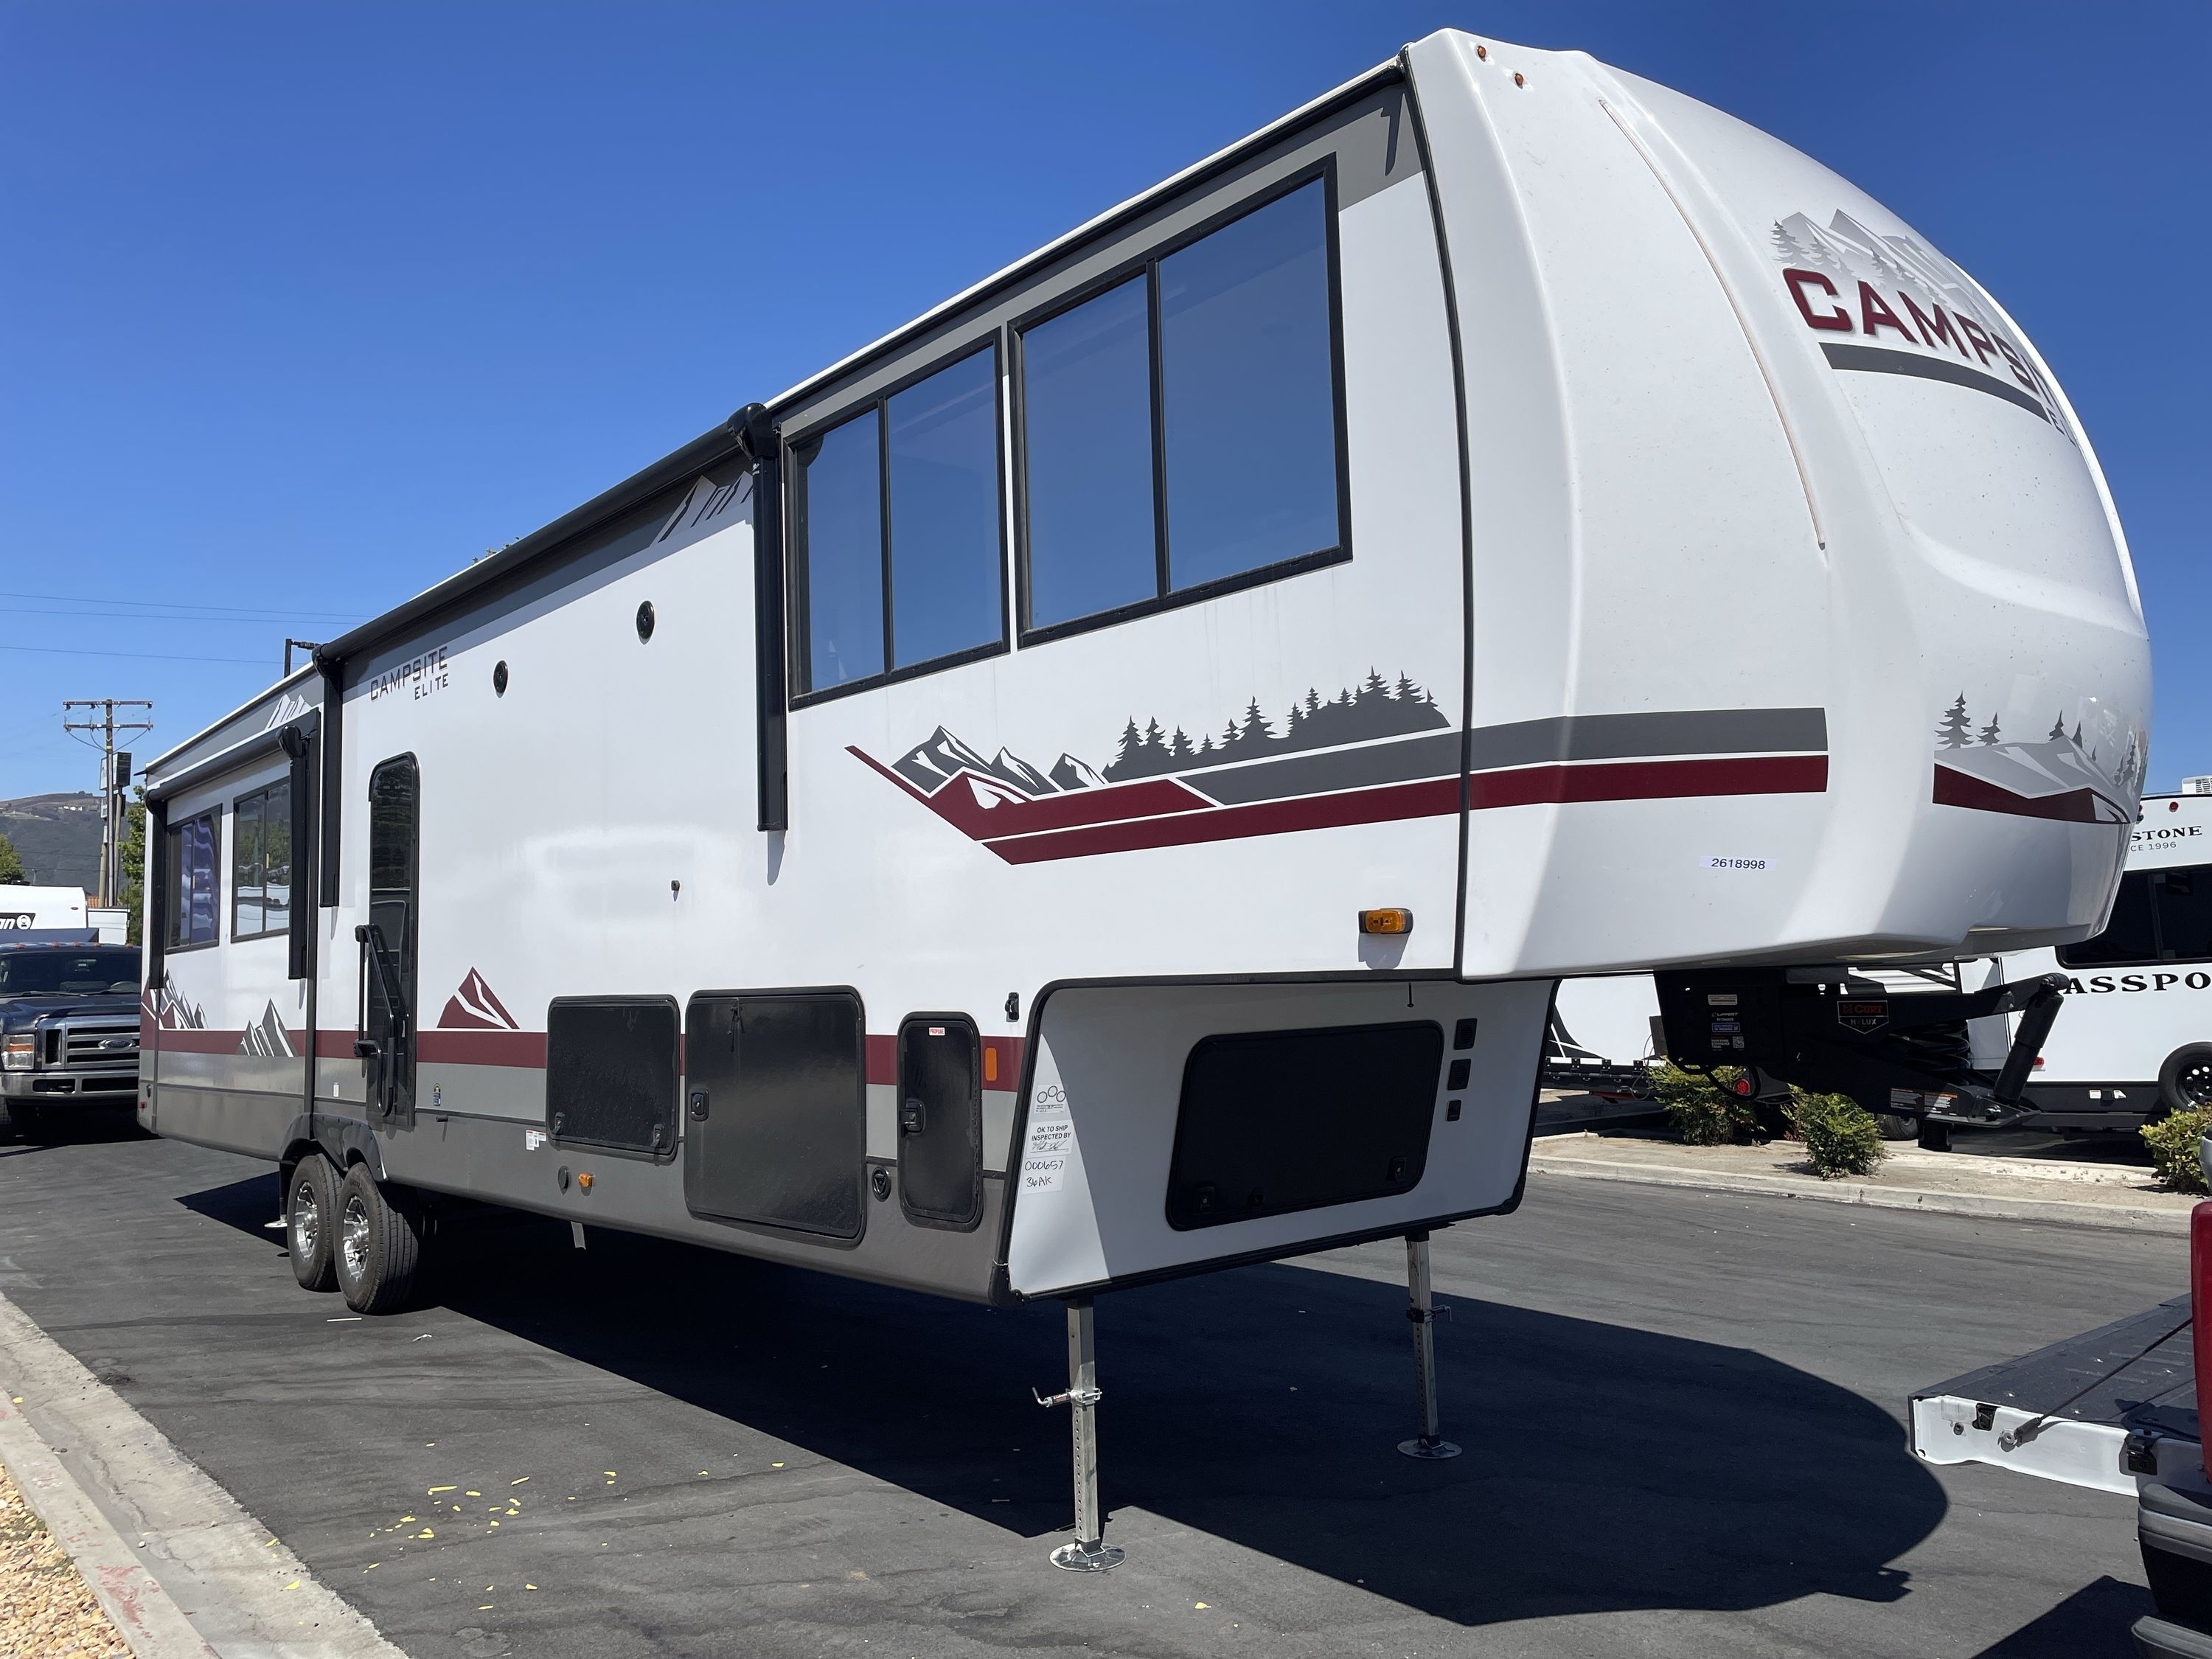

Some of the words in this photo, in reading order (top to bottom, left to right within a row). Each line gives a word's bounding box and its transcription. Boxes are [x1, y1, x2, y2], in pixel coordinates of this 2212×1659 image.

[370, 646, 448, 700] CAMPSITE
[414, 672, 448, 700] ELITE
[2149, 841, 2177, 850] 1996
[1711, 858, 1766, 870] 2618998
[1032, 1133, 1062, 1141] INSPECTED
[1025, 1160, 1063, 1171] 000657
